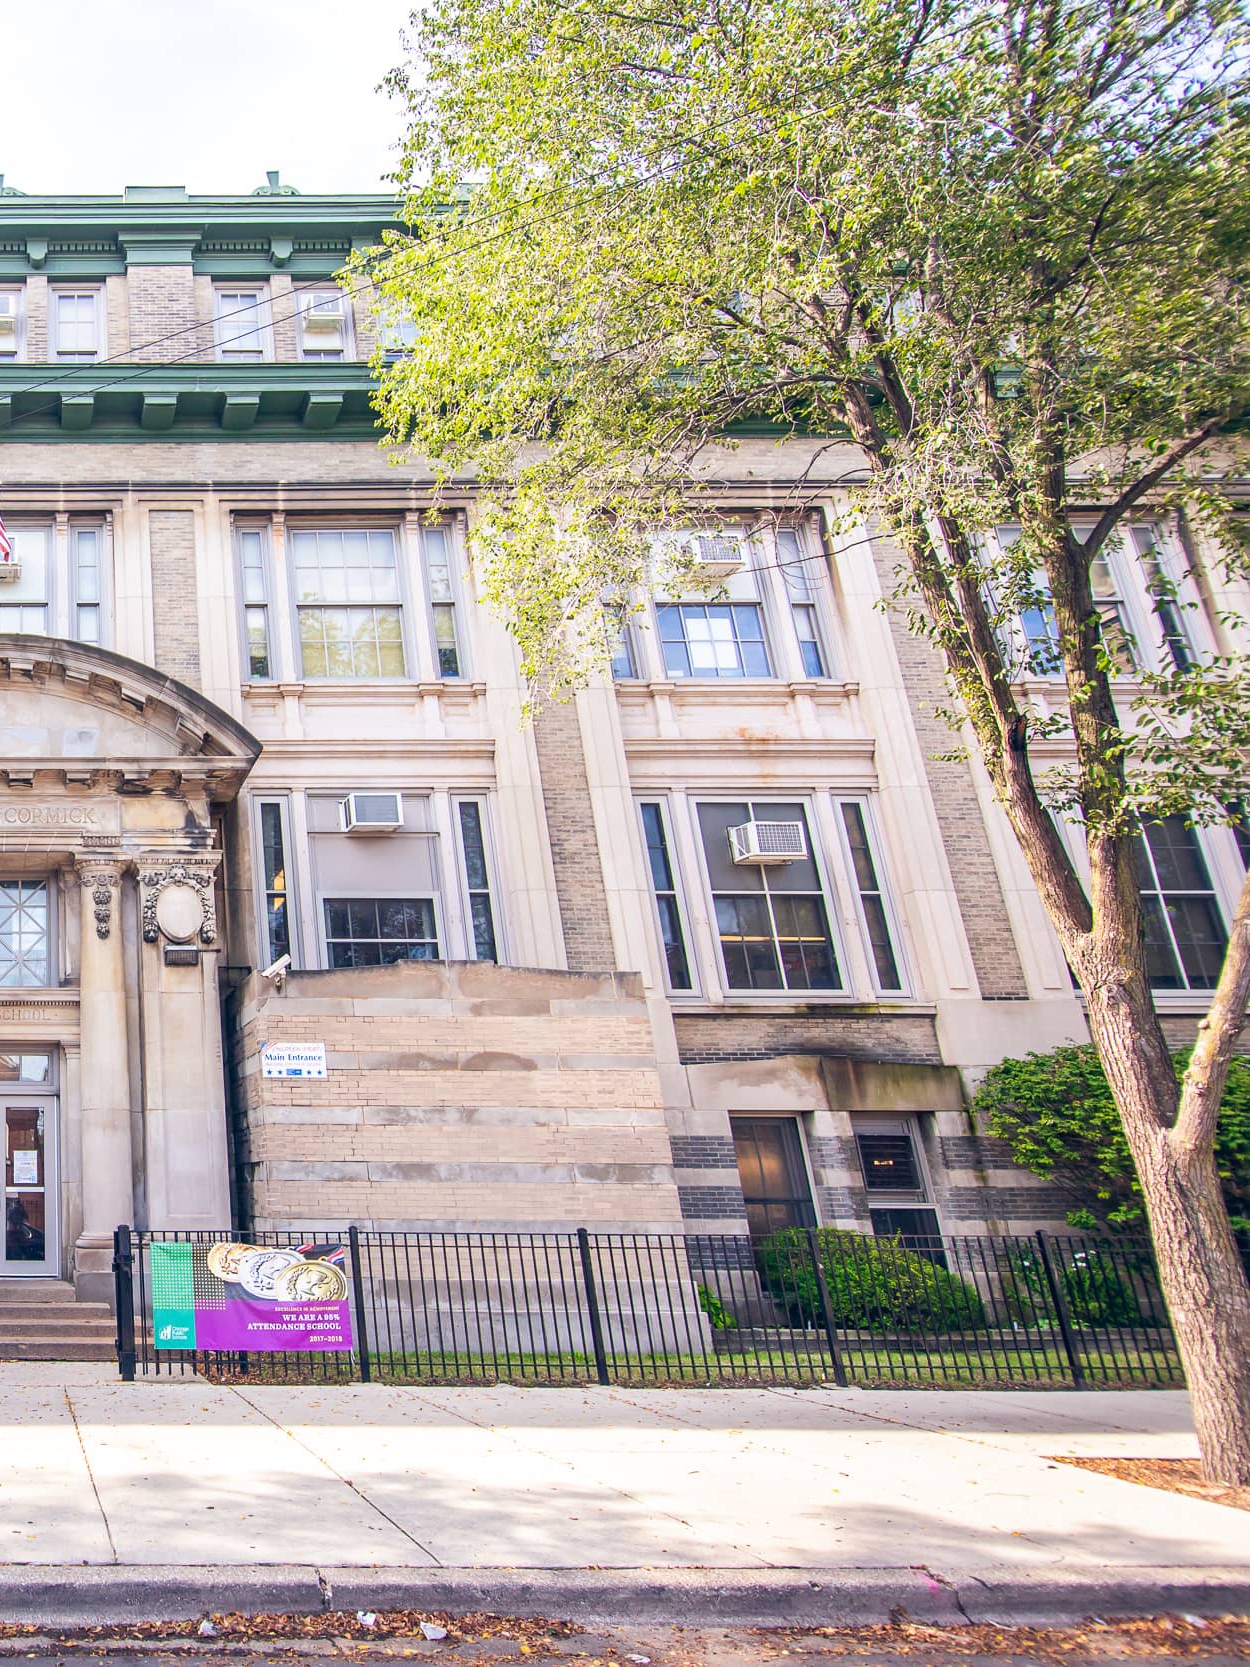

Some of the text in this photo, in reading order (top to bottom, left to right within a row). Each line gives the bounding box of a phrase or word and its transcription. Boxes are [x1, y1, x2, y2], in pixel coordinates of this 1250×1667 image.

[282, 1314, 297, 1322] WE
[298, 1314, 316, 1322] ARE
[324, 1313, 340, 1321] 95%
[247, 1322, 341, 1331] ATTENDANCE SCHOOL
